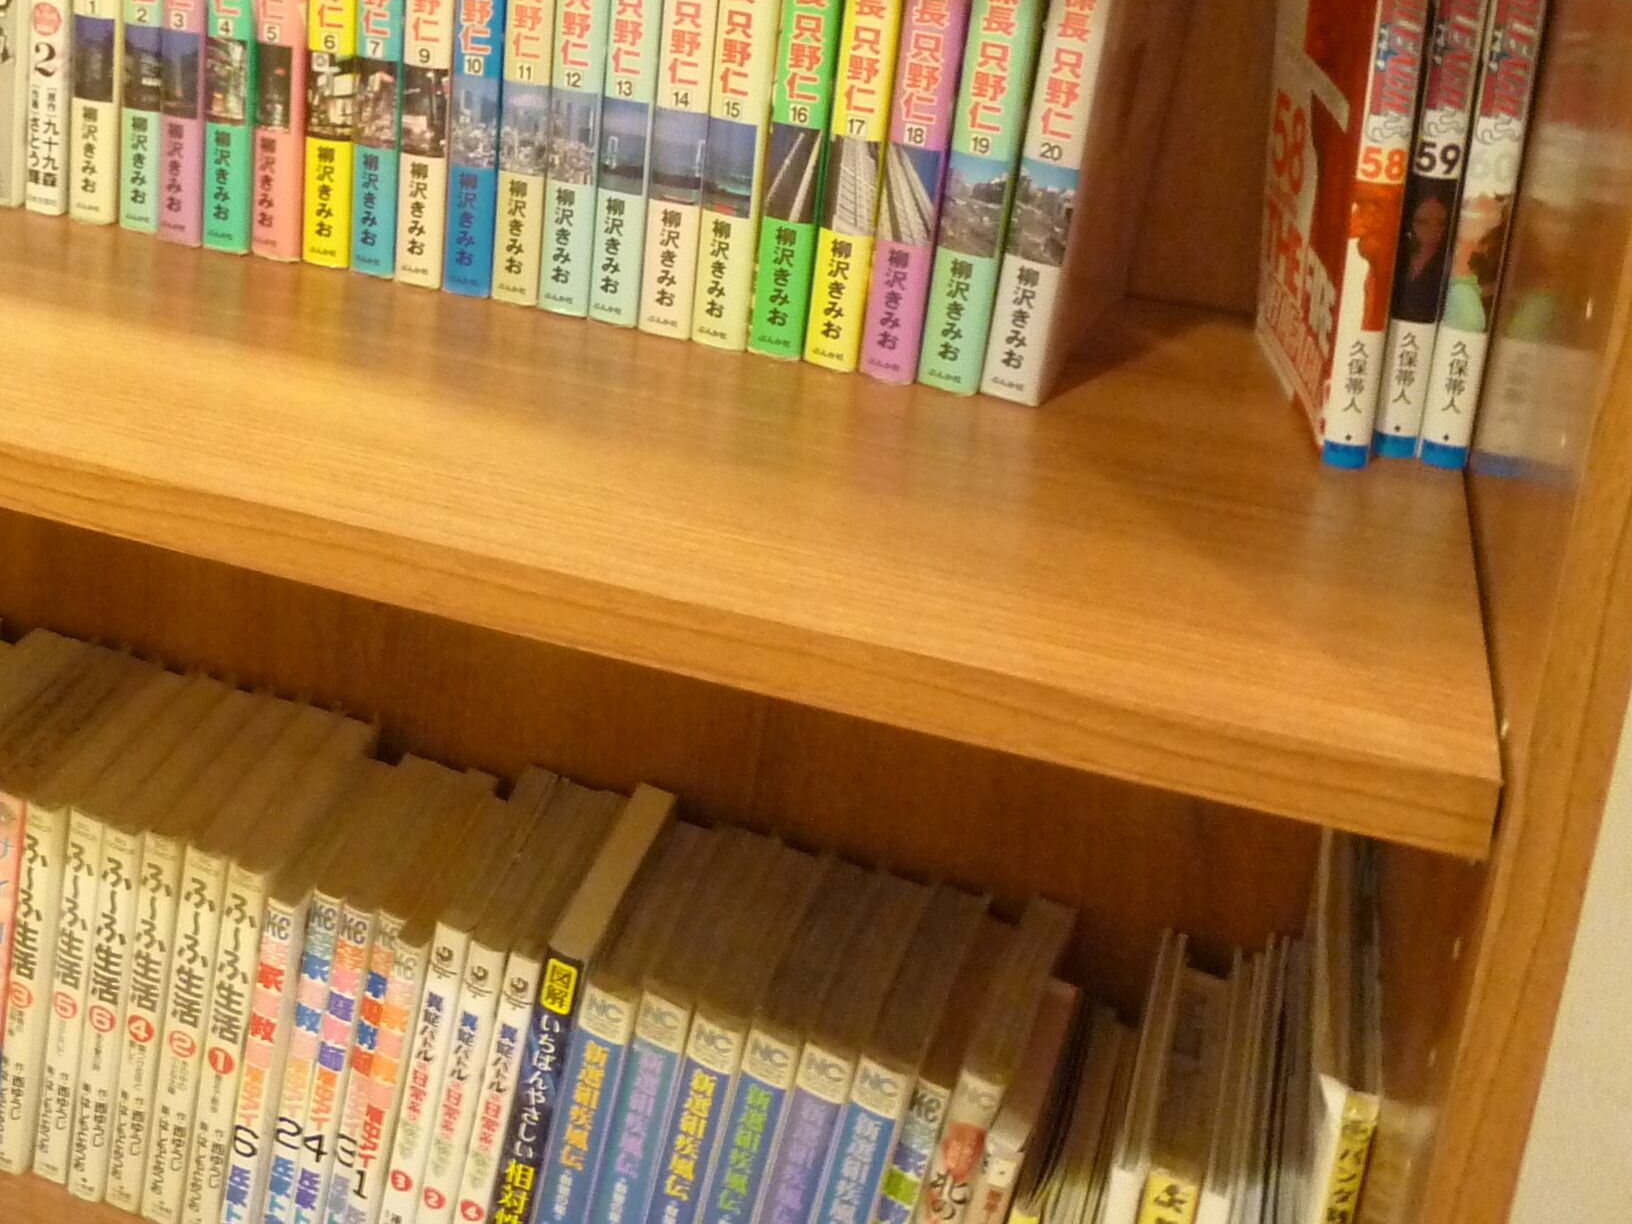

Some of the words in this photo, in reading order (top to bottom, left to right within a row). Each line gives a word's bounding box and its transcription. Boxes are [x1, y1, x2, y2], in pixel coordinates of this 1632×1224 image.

[90, 1, 96, 14] 1
[137, 8, 147, 22] 2
[219, 21, 230, 35] 4
[324, 35, 335, 49] 6
[34, 42, 56, 77] 2
[419, 47, 431, 63] 9
[466, 58, 481, 75] 10
[519, 65, 531, 80] 11
[565, 72, 581, 87] 12
[616, 81, 632, 97] 13
[673, 91, 689, 109] 14
[791, 106, 808, 123] 16
[847, 117, 865, 135] 17
[906, 126, 925, 145] 18
[971, 136, 989, 153] 19
[1040, 143, 1062, 162] 20
[1415, 142, 1461, 174] 59
[1361, 146, 1407, 180] 58
[515, 1015, 561, 1158] いちばんやさしい
[234, 1125, 259, 1157] 6
[274, 1117, 302, 1149] 2
[304, 1135, 327, 1163] 4
[336, 1133, 357, 1168] 3
[353, 1170, 367, 1200] 1
